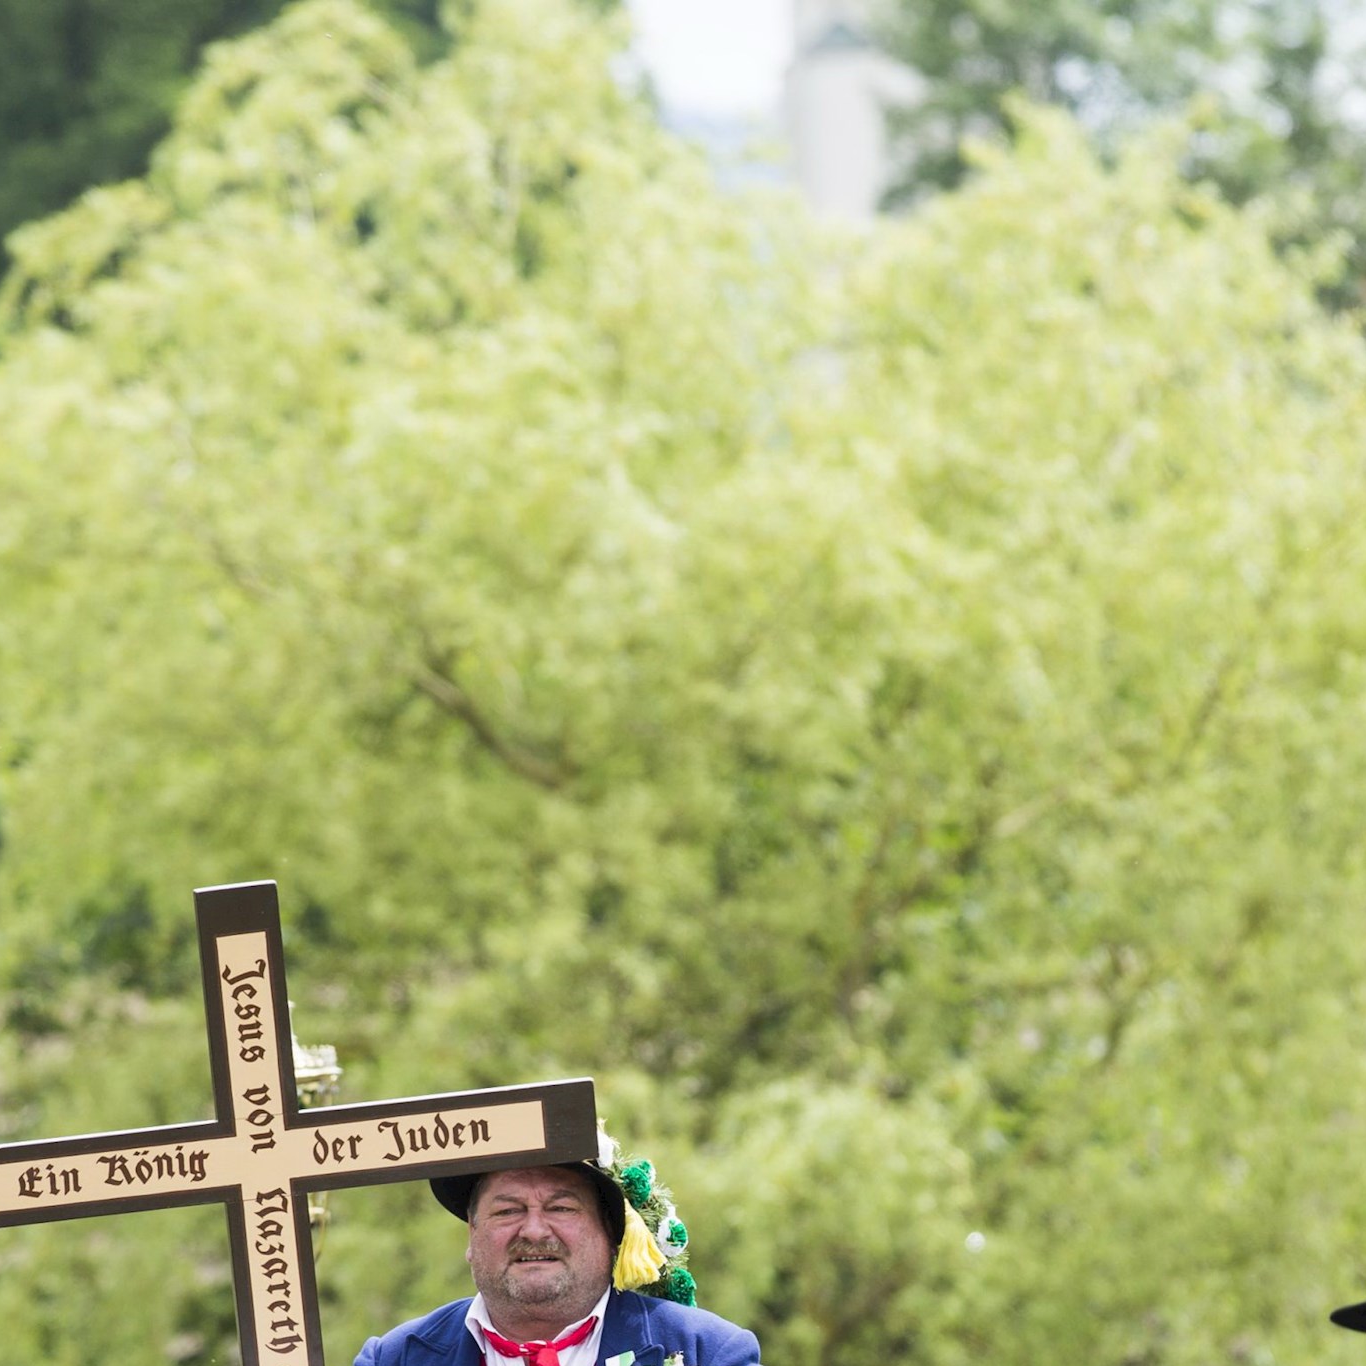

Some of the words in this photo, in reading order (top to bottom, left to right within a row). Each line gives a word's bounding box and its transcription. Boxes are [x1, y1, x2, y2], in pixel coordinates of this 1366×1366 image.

[223, 957, 267, 1065] Jesus
[18, 1163, 82, 1200] Ein
[95, 1144, 211, 1186] König
[311, 1126, 365, 1166] der
[376, 1112, 493, 1162] Juden
[242, 1083, 277, 1154] von
[254, 1186, 304, 1354] Nazareth
